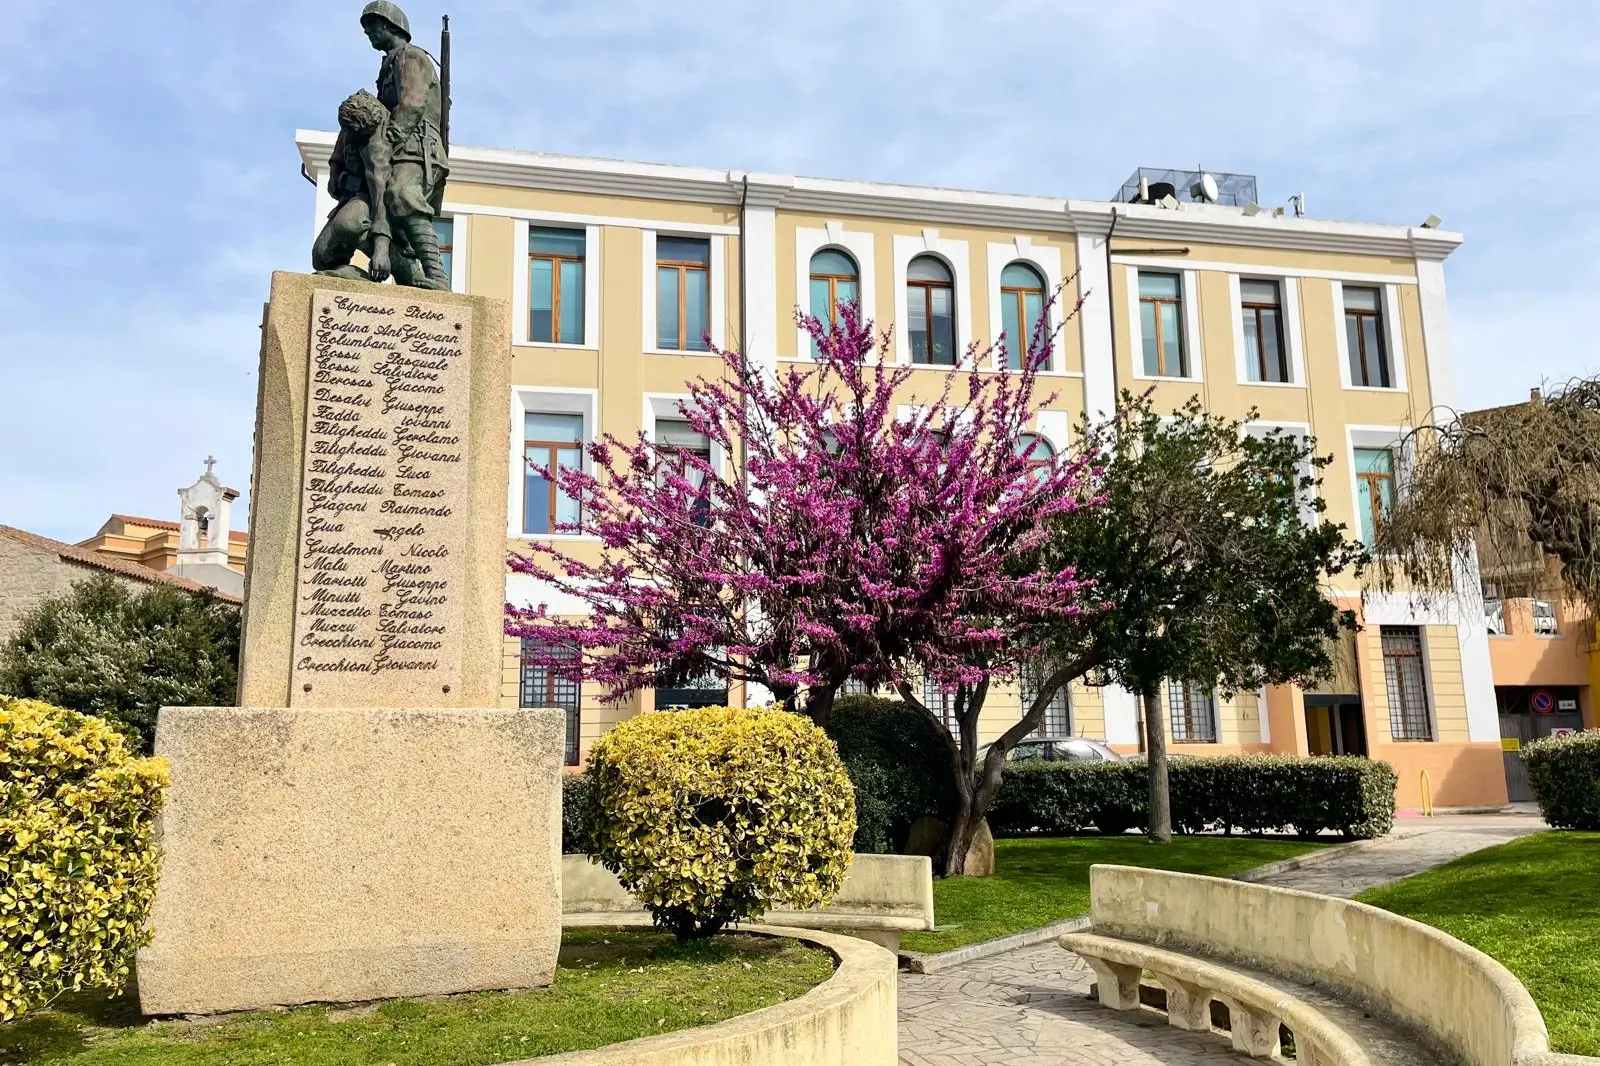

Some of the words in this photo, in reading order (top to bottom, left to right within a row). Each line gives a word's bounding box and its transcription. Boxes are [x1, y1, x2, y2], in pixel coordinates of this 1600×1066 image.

[334, 296, 396, 315] Cipresso
[404, 305, 445, 320] Pietro
[318, 316, 370, 333] Codina
[316, 330, 397, 350] Columbanu
[409, 341, 463, 357] Santino
[315, 355, 360, 373] Cossu
[370, 362, 438, 381] Salvatore
[316, 344, 361, 360] Cossu
[386, 352, 449, 370] Pasquale
[313, 370, 375, 388] Derosas
[385, 377, 446, 395] Giacomo
[312, 404, 362, 421] Fadda
[313, 387, 372, 408] Desalvi
[381, 394, 445, 418] Giuseppe
[310, 421, 389, 443] Filigheddu
[392, 426, 460, 446] Gerolamo
[310, 440, 388, 461] Filigheddu
[397, 444, 462, 463] Giovanni
[308, 459, 387, 480] Filigheddu
[395, 465, 432, 479] Luca
[306, 478, 385, 500] Filigheddu
[393, 483, 446, 498] Tomaso
[307, 494, 368, 518] Giagoni
[379, 500, 452, 517] Raimondo
[305, 516, 345, 536] Giua
[303, 556, 349, 572] Malu
[371, 559, 432, 575] Martino
[303, 571, 368, 587] Mariotti
[382, 573, 448, 594] Giuseppe
[303, 588, 361, 603] Minutti
[394, 589, 448, 609] Gavino
[301, 602, 372, 618] Muzzetto
[379, 603, 433, 619] Tomaso
[375, 619, 446, 634] Salvatore
[300, 632, 375, 648] Orecchioni
[379, 634, 442, 655] Giacomo
[297, 656, 373, 672] Orecchioni
[370, 653, 438, 675] Giovanni
